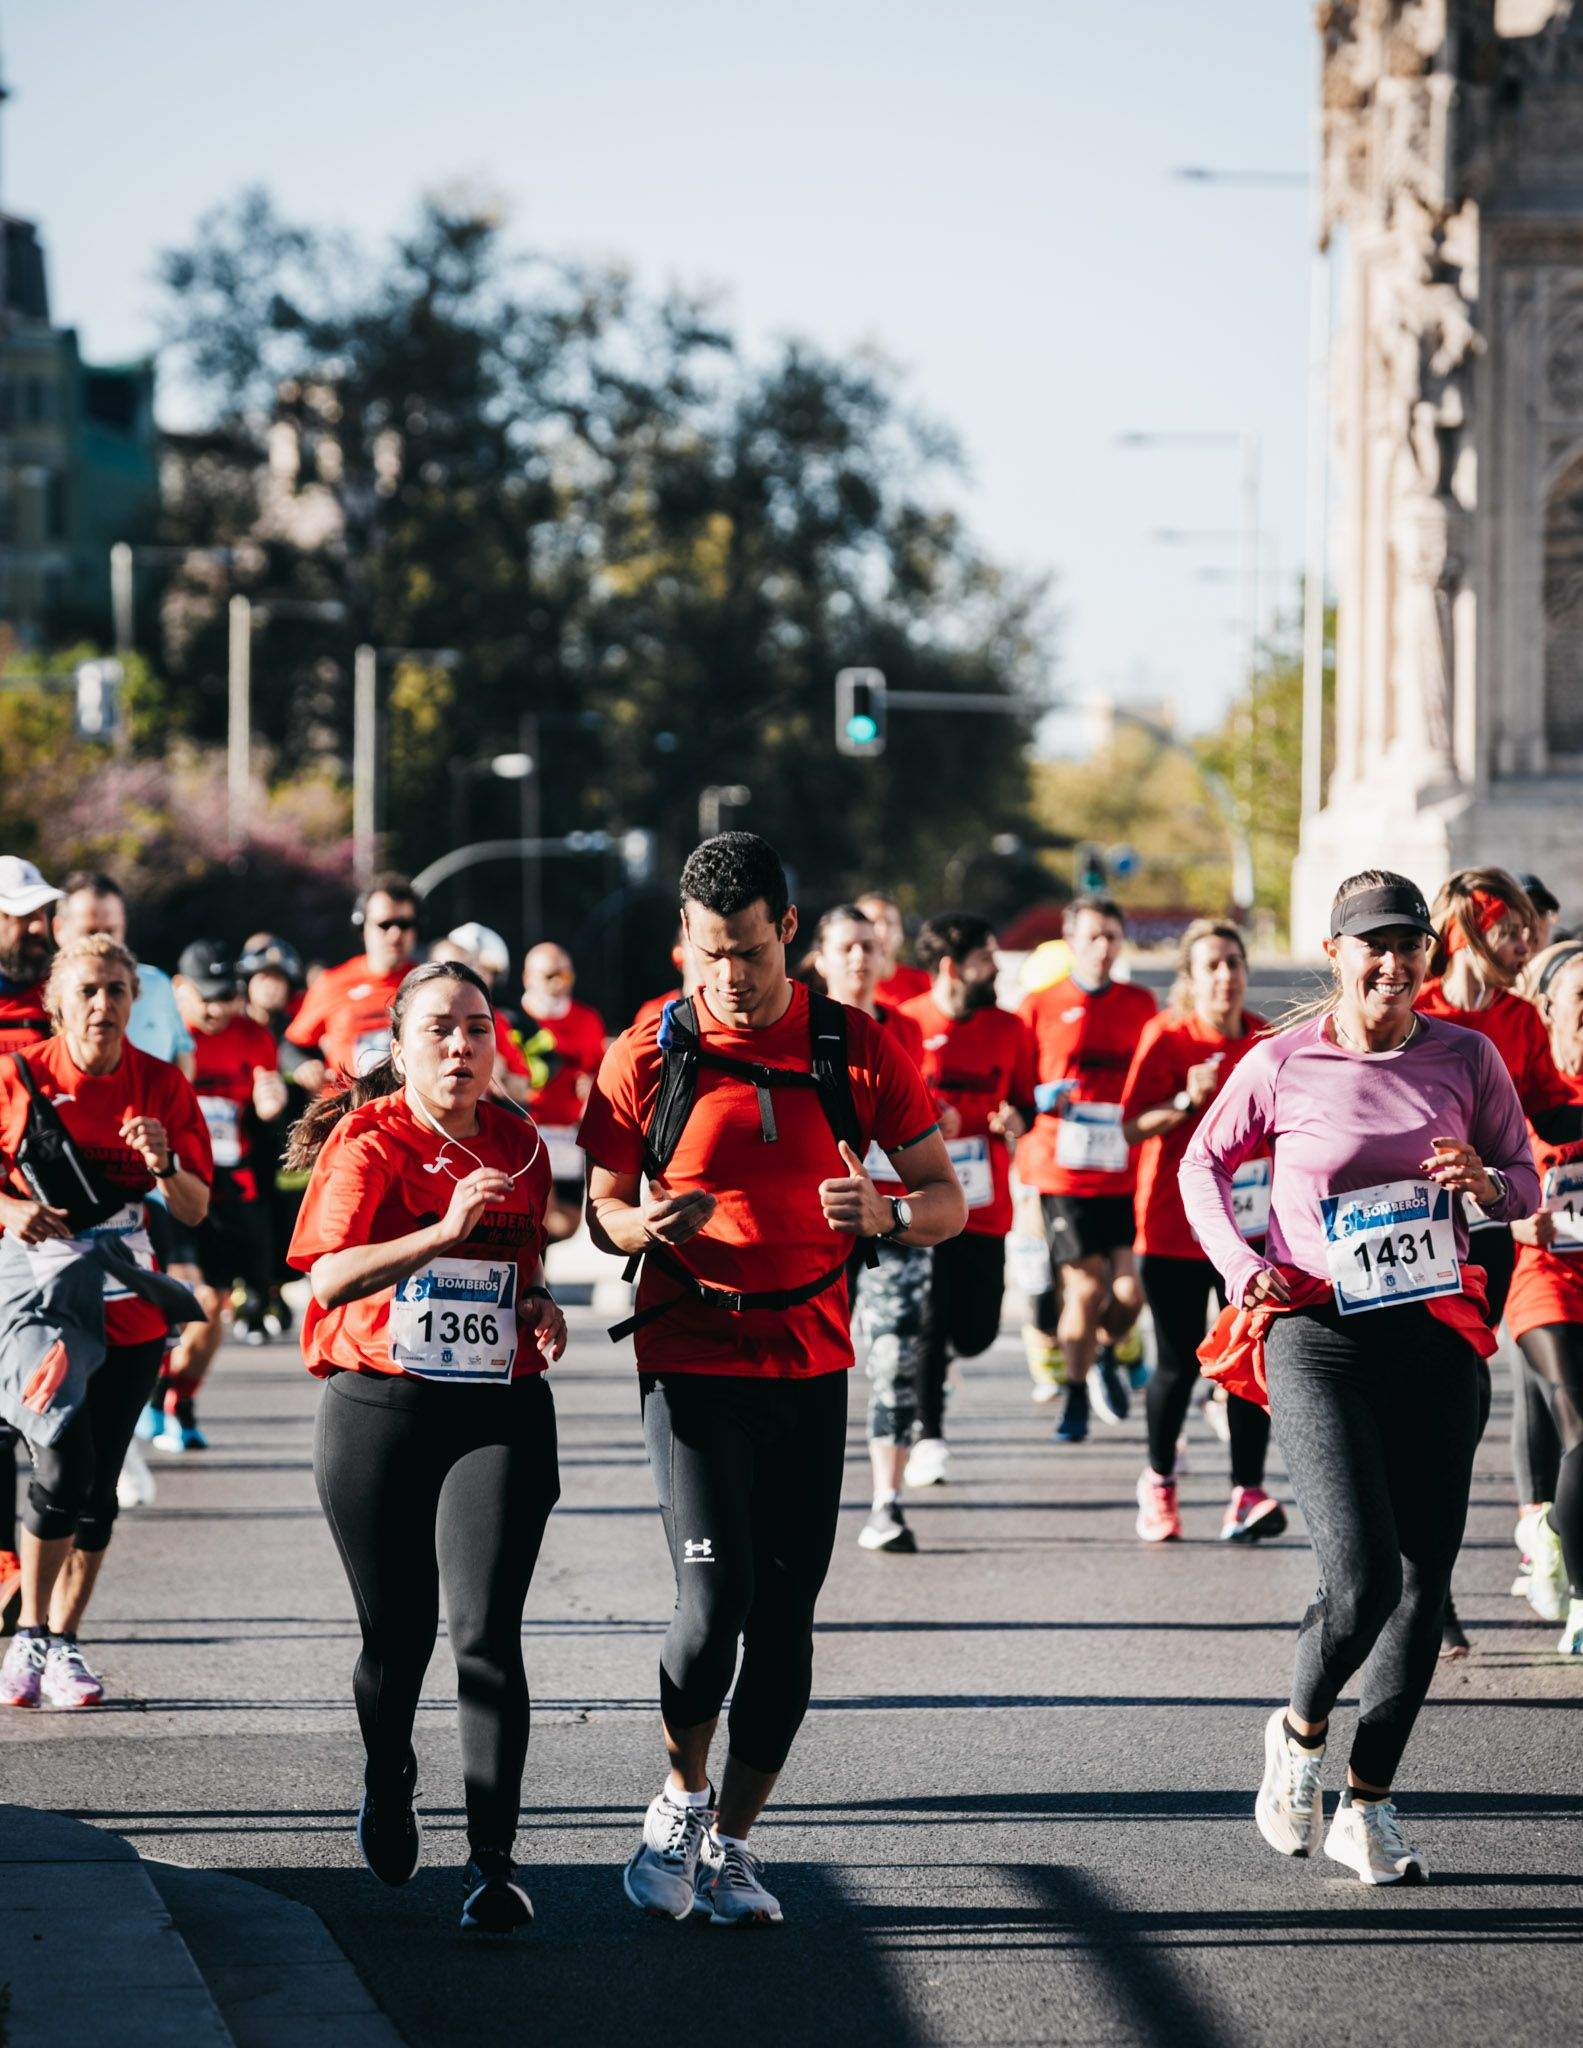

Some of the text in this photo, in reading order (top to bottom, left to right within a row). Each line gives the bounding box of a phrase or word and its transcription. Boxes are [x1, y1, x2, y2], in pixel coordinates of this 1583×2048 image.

[1363, 1198, 1427, 1219] BOMBEROS
[1354, 1229, 1436, 1272] 1431
[437, 1278, 499, 1292] BOMBEROS
[418, 1310, 499, 1345] 1366
